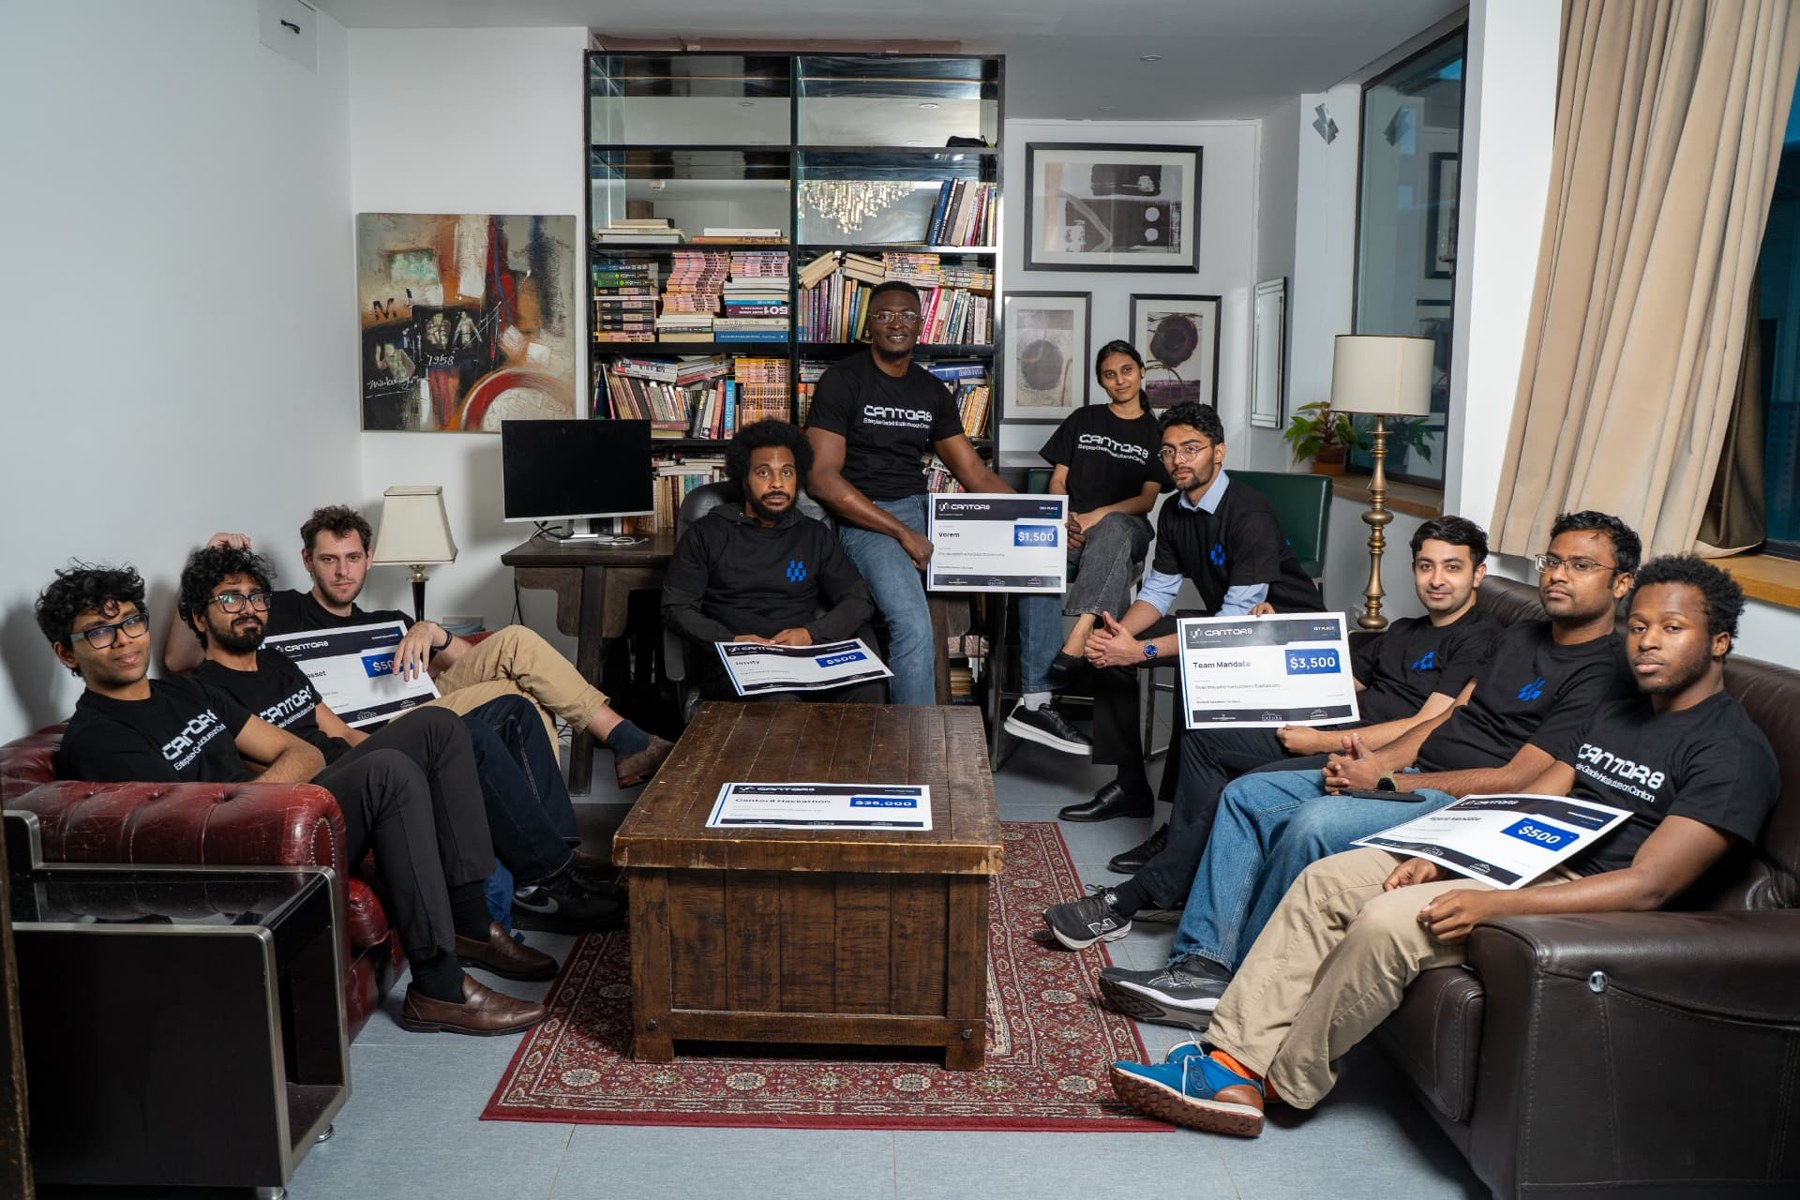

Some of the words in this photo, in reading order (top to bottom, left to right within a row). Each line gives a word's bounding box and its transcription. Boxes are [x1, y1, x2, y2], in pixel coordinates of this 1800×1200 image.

[763, 305, 788, 315] 501
[427, 354, 455, 366] 1958
[863, 404, 933, 422] CANTOR8
[1079, 433, 1149, 459] CANTOR8
[1018, 532, 1054, 542] $1,500
[284, 640, 329, 652] CANTOR8
[826, 654, 857, 665] $500
[1290, 656, 1336, 670] $3,500
[372, 660, 395, 672] $50
[1577, 743, 1665, 790] CANTOR8
[1518, 824, 1561, 844] $500
